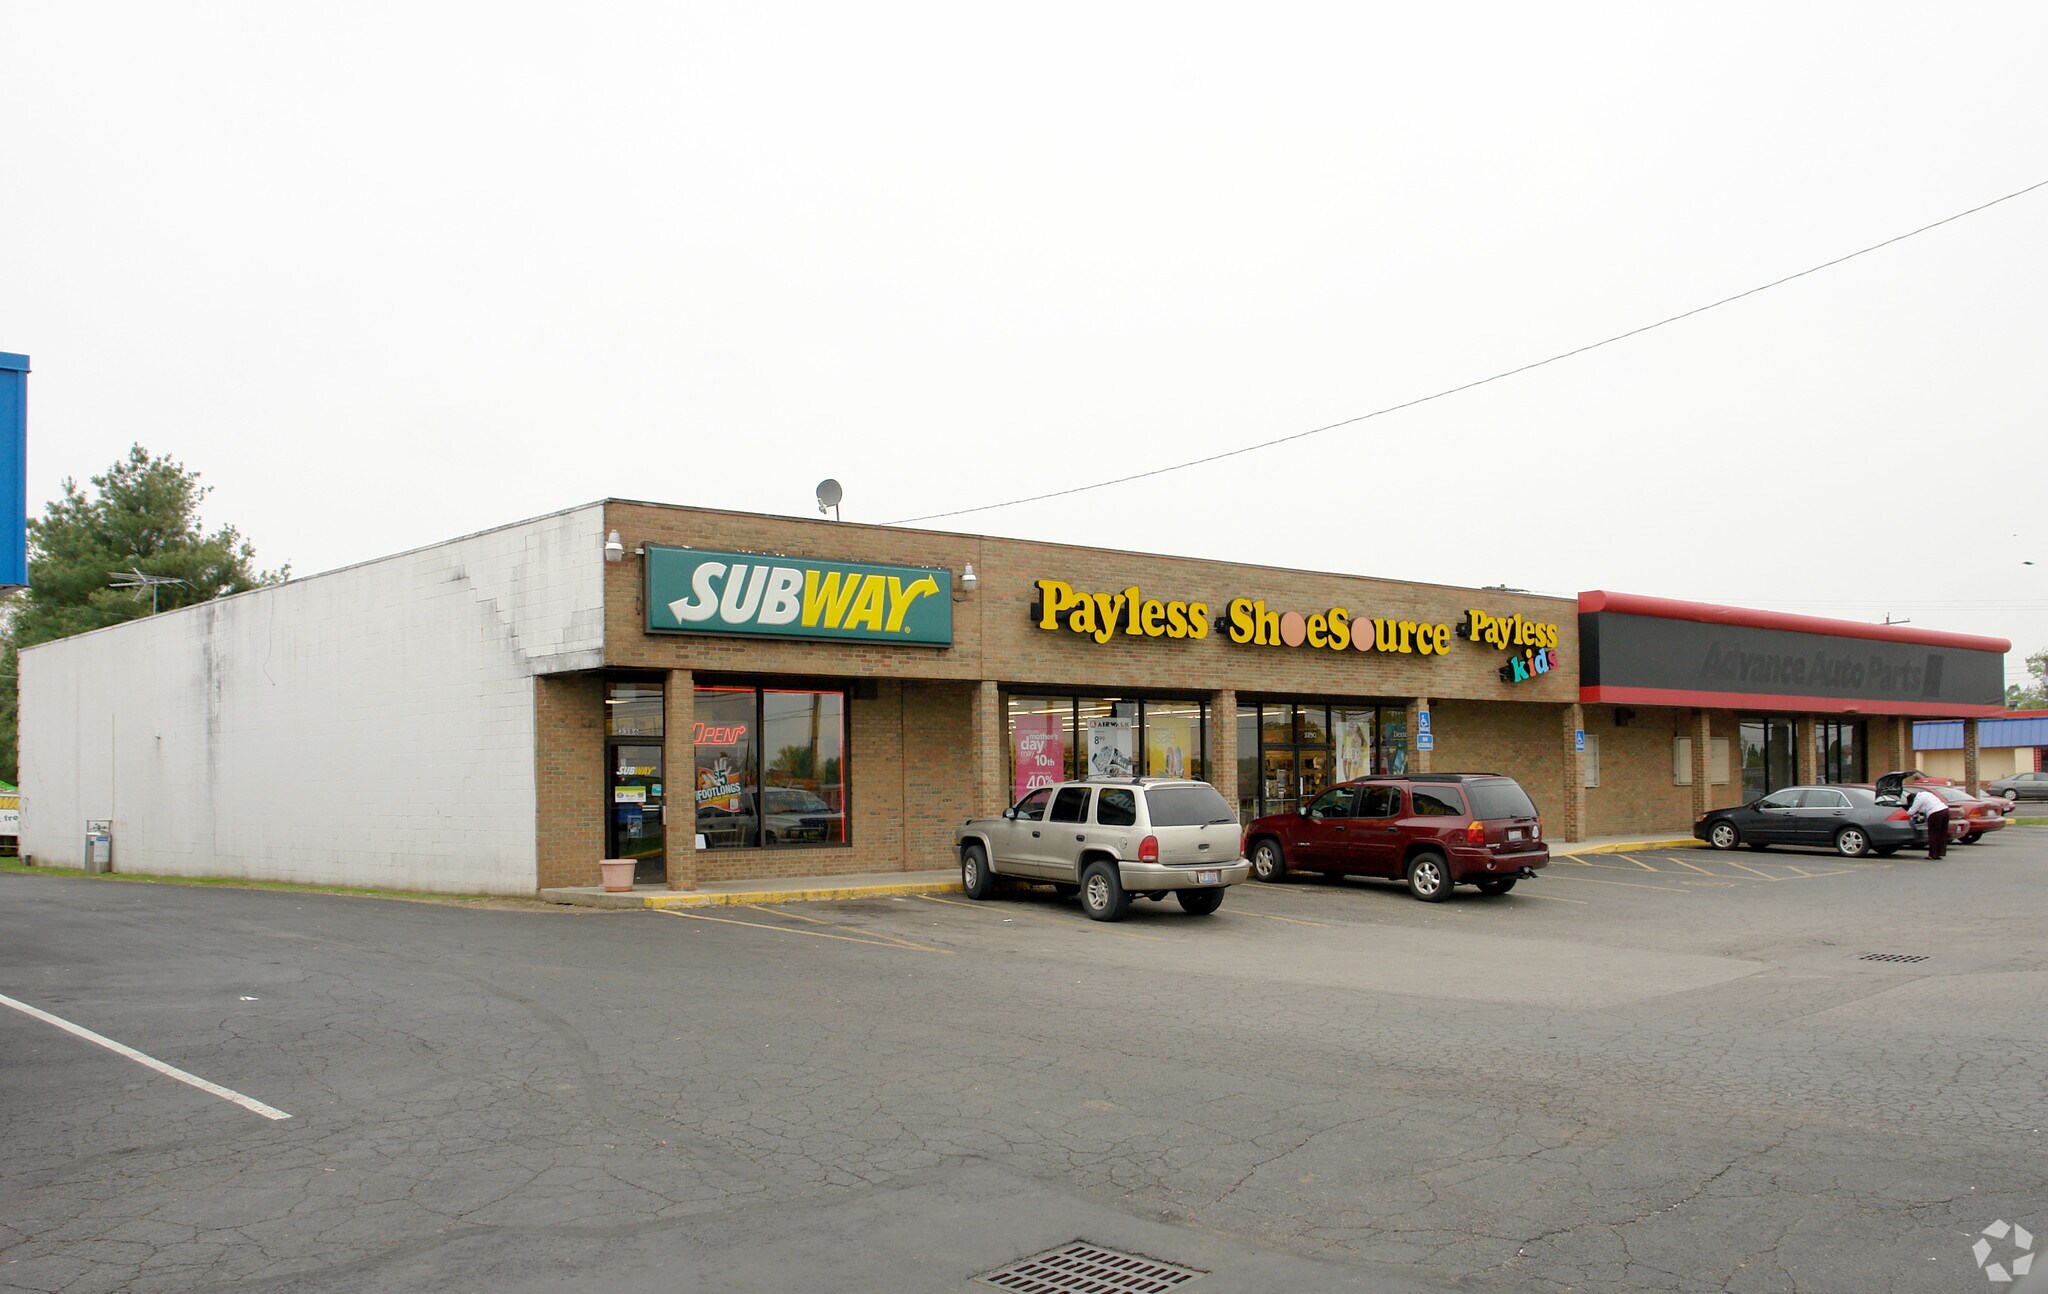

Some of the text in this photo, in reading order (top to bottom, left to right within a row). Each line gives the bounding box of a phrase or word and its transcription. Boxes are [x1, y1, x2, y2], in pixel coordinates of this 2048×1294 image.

[668, 561, 940, 632] SUBWAY
[1037, 579, 1450, 655] Payless ShoeSource
[1468, 609, 1559, 651] Payless
[1511, 647, 1559, 683] kids
[1698, 640, 1922, 692] Advance Auto Parts
[693, 722, 746, 745] OPEN
[1029, 732, 1059, 740] mother's
[1020, 736, 1045, 754] day
[616, 766, 656, 775] SUBWAY
[713, 769, 728, 786] $5
[697, 783, 741, 800] FOOTLONGS
[1025, 775, 1054, 789] 40%
